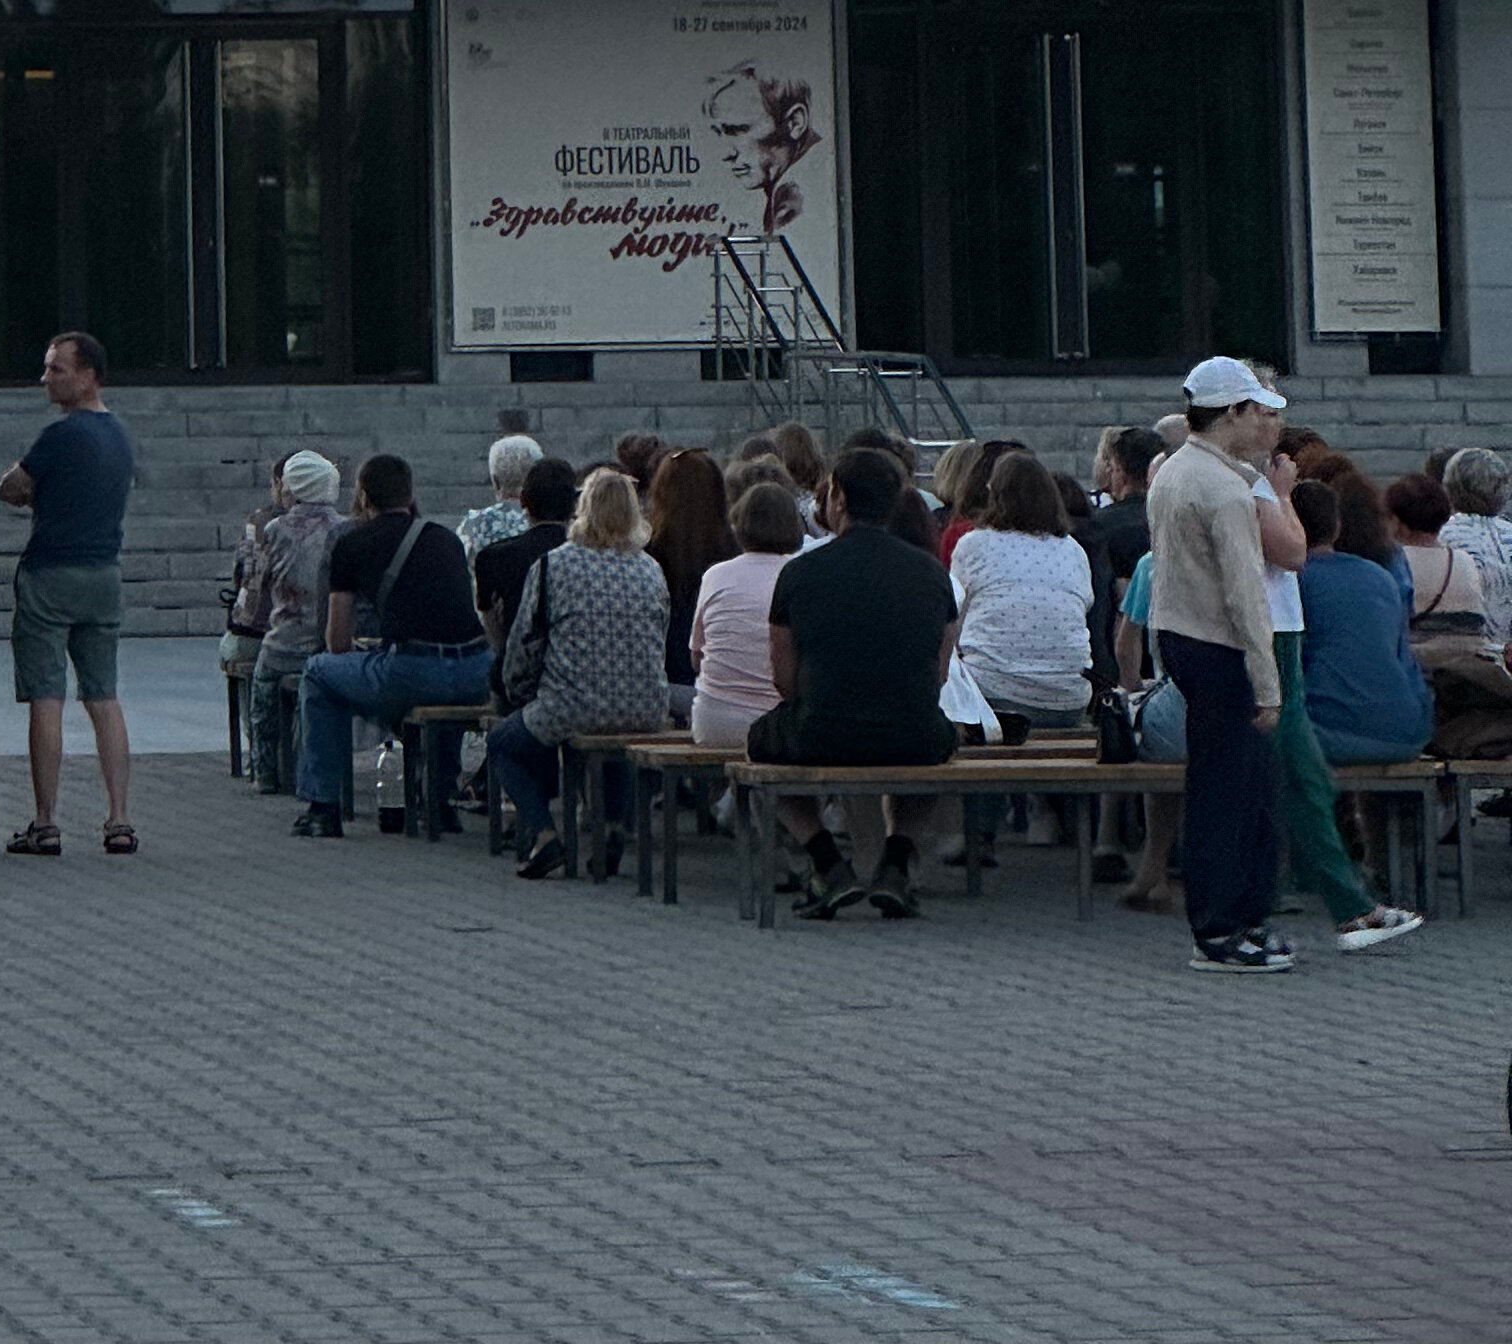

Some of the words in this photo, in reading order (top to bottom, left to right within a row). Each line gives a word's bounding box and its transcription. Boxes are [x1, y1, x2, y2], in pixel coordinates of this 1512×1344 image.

[775, 15, 808, 32] 2024
[613, 126, 692, 141] ТЕАТРАЛЬНЫЙ
[554, 144, 702, 177] ФЕСТИВАЛЬ
